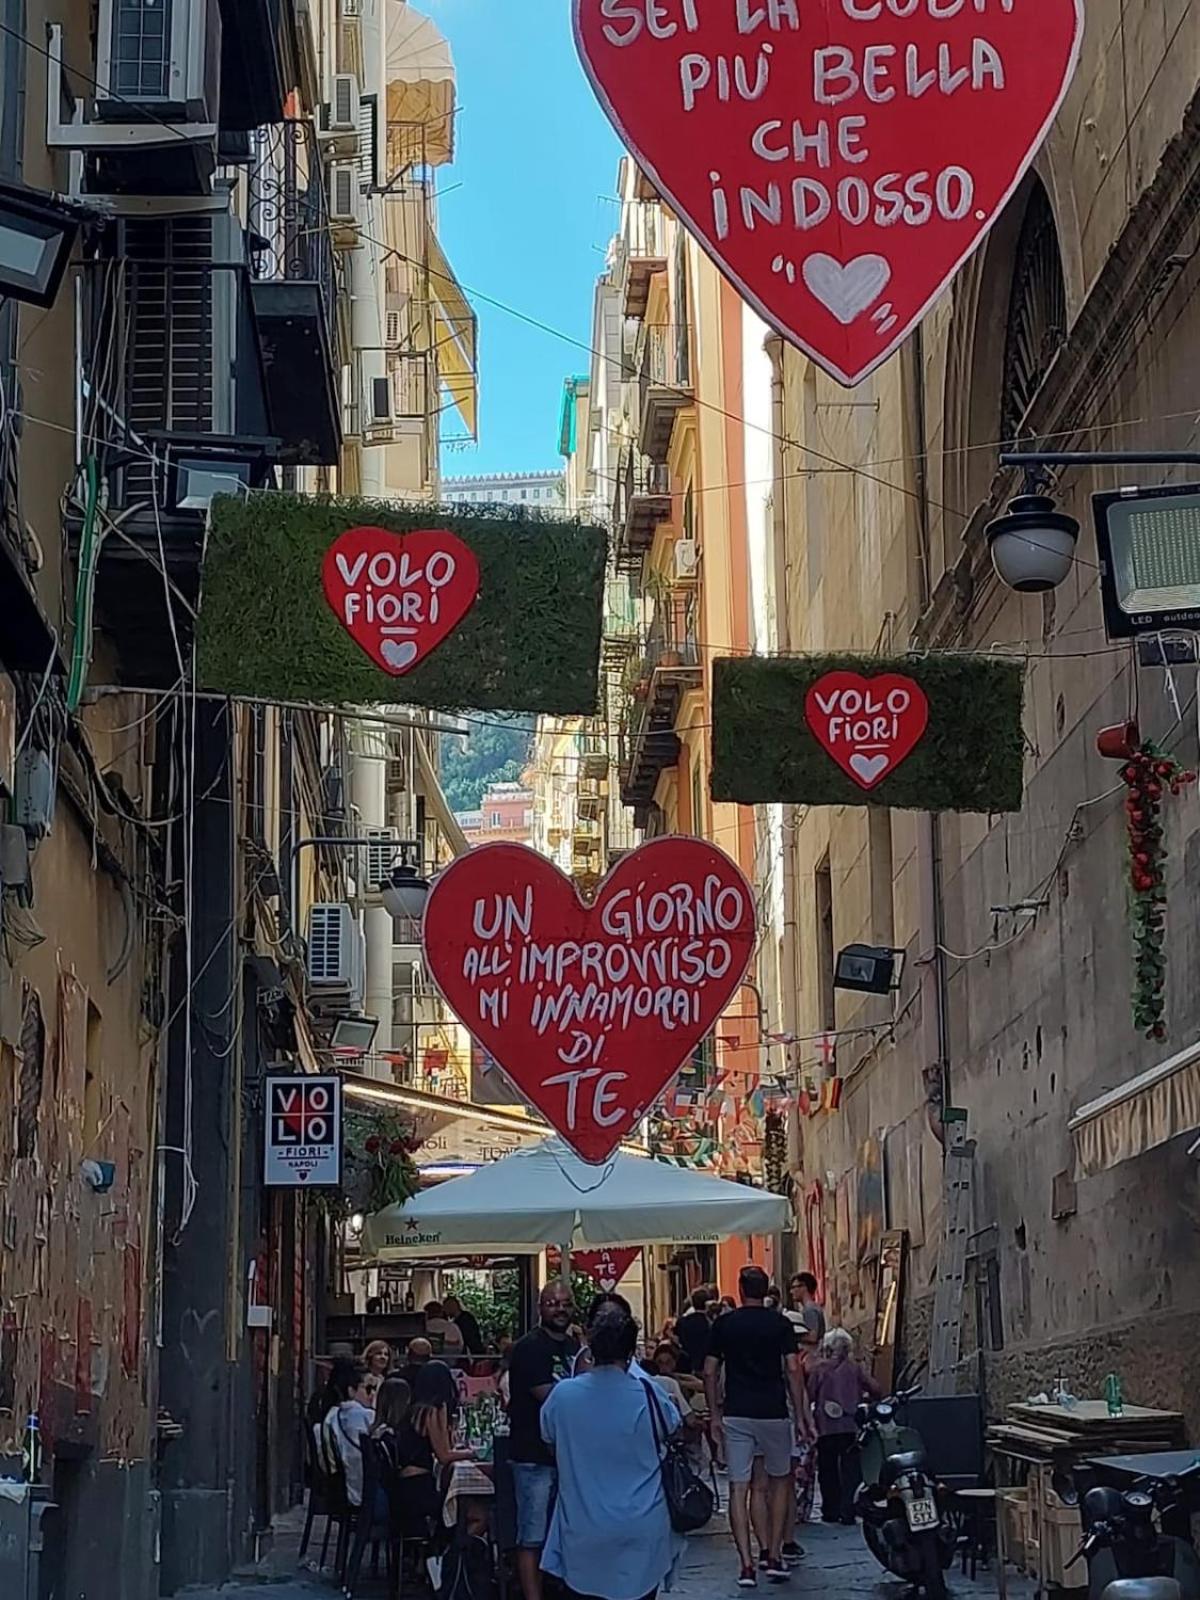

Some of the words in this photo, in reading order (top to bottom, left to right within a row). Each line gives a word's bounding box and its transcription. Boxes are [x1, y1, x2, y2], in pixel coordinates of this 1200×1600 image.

[813, 38, 1005, 105] BELLA
[752, 115, 868, 167] CHE
[336, 551, 455, 587] VOLO
[1131, 615, 1153, 625] LED
[814, 689, 910, 714] VOLO
[472, 885, 533, 940] UN
[385, 1232, 440, 1245] Heineken
[594, 1262, 617, 1276] TE
